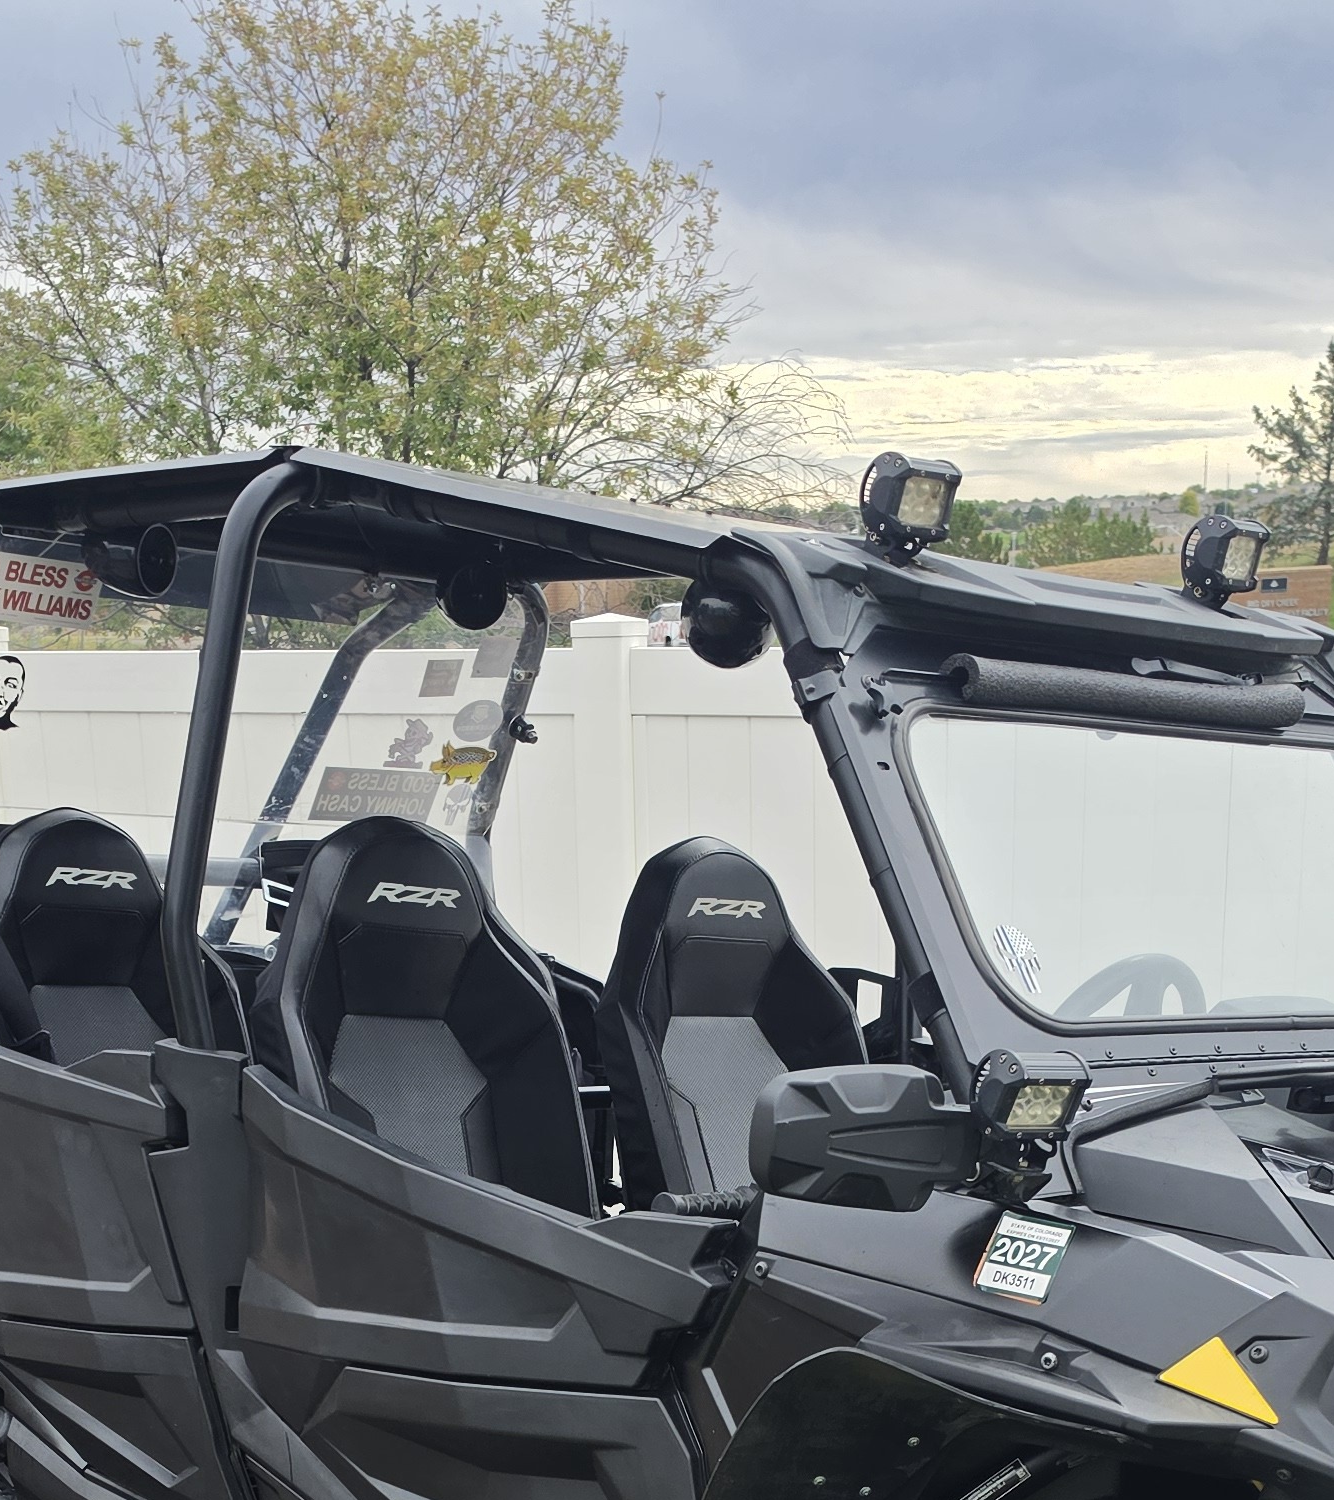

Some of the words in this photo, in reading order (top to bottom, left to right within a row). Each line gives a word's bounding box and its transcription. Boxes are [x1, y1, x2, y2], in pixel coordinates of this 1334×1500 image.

[5, 560, 69, 589] BLESS
[2, 588, 93, 621] WILLIAMS
[45, 866, 138, 890] RZR
[366, 881, 462, 909] RZR
[687, 897, 767, 919] RZR
[1035, 1228, 1063, 1237] COLORADO
[989, 1237, 1059, 1270] 2027
[992, 1270, 1036, 1290] DK3511
